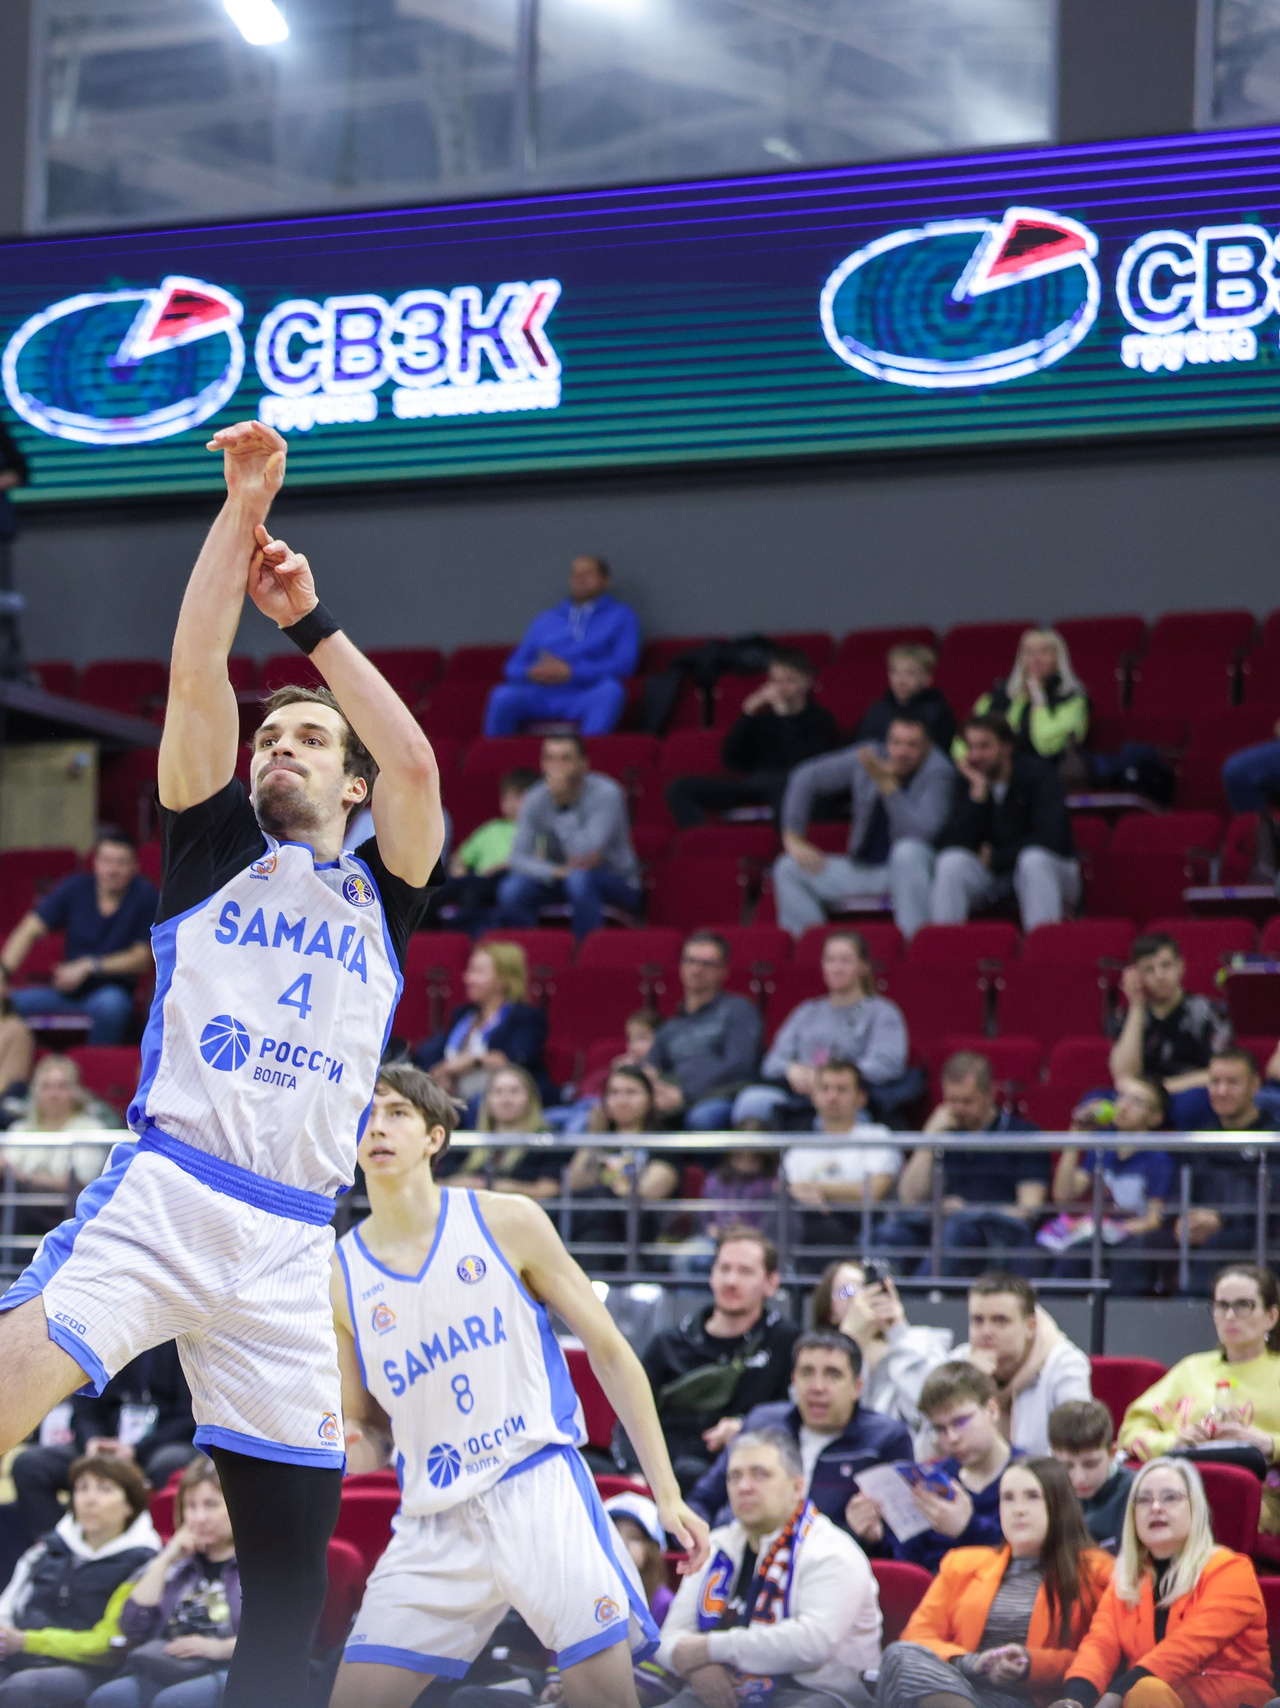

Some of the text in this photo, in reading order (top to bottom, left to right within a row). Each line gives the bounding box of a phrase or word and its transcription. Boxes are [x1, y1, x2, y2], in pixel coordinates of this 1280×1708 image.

[1116, 223, 1280, 335] СВ
[214, 901, 368, 984] SAMARA
[277, 973, 313, 1020] 4
[253, 1066, 297, 1090] ВОЛГА
[54, 1310, 87, 1335] ZEDO
[384, 1307, 507, 1397] SAMARA
[450, 1374, 474, 1415] 8
[465, 1456, 500, 1476] ВОЛГА
